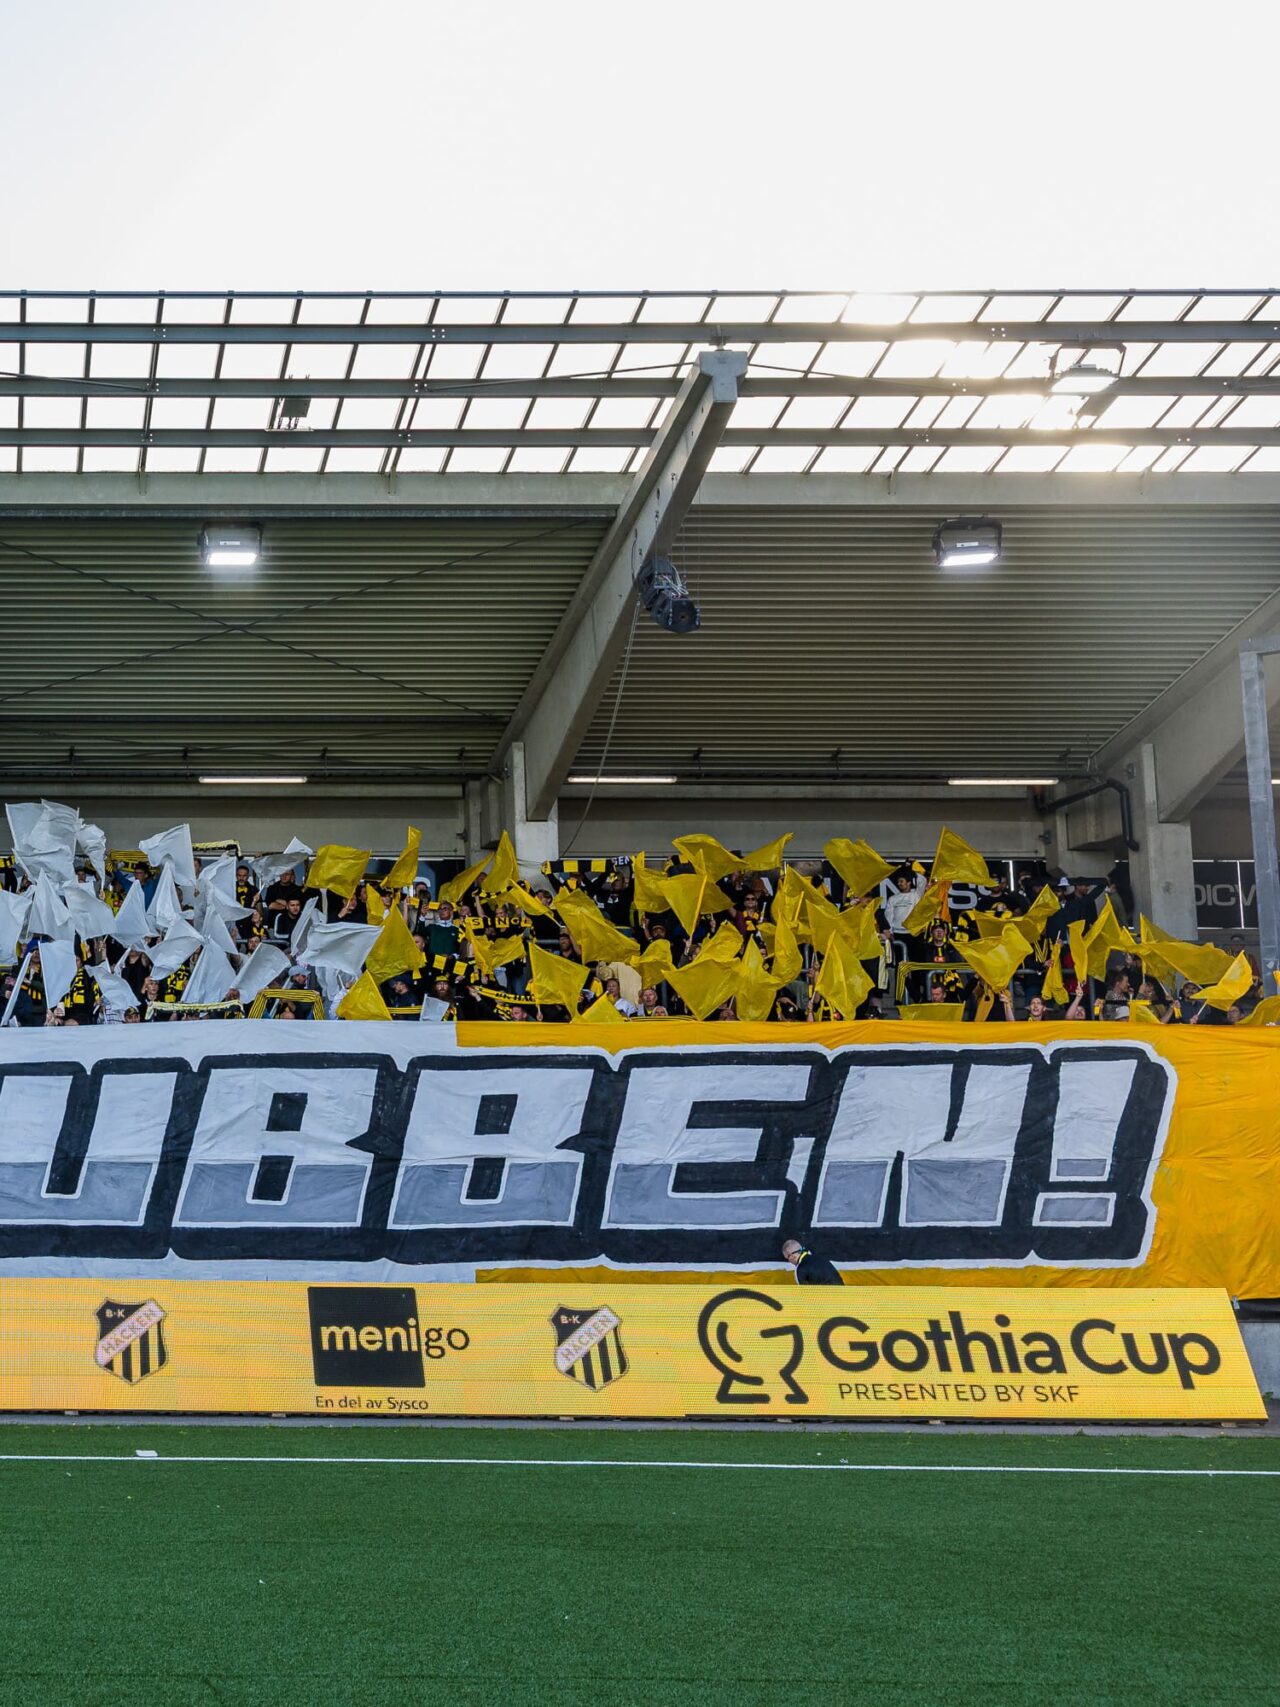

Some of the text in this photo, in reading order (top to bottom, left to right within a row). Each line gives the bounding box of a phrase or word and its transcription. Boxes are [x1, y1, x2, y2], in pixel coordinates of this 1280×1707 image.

[320, 1317, 470, 1359] menigo
[817, 1311, 1221, 1390] Gothia Cup
[315, 1396, 429, 1412] En del av Sysco
[838, 1382, 1080, 1403] PRESENTED BY SKF
